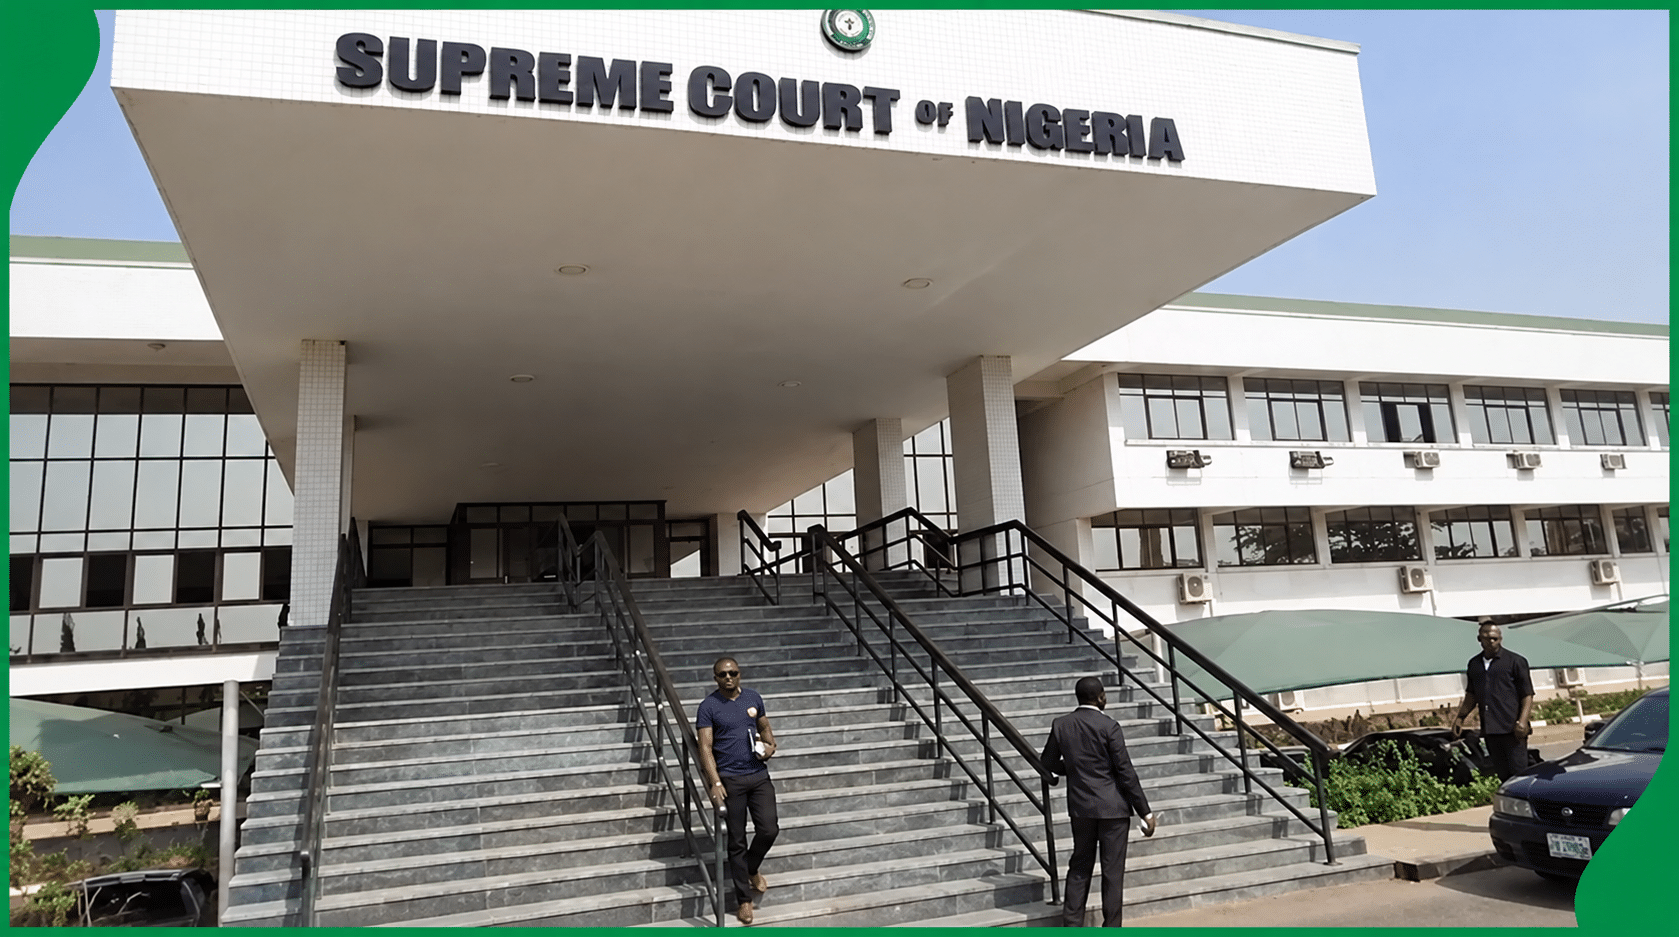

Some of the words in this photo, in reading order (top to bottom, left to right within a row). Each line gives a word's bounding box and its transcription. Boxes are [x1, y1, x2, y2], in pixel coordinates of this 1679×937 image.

[336, 33, 674, 115] SUPREME
[688, 66, 900, 136] COURT
[915, 100, 953, 128] OF
[966, 96, 1185, 163] NIGERIA
